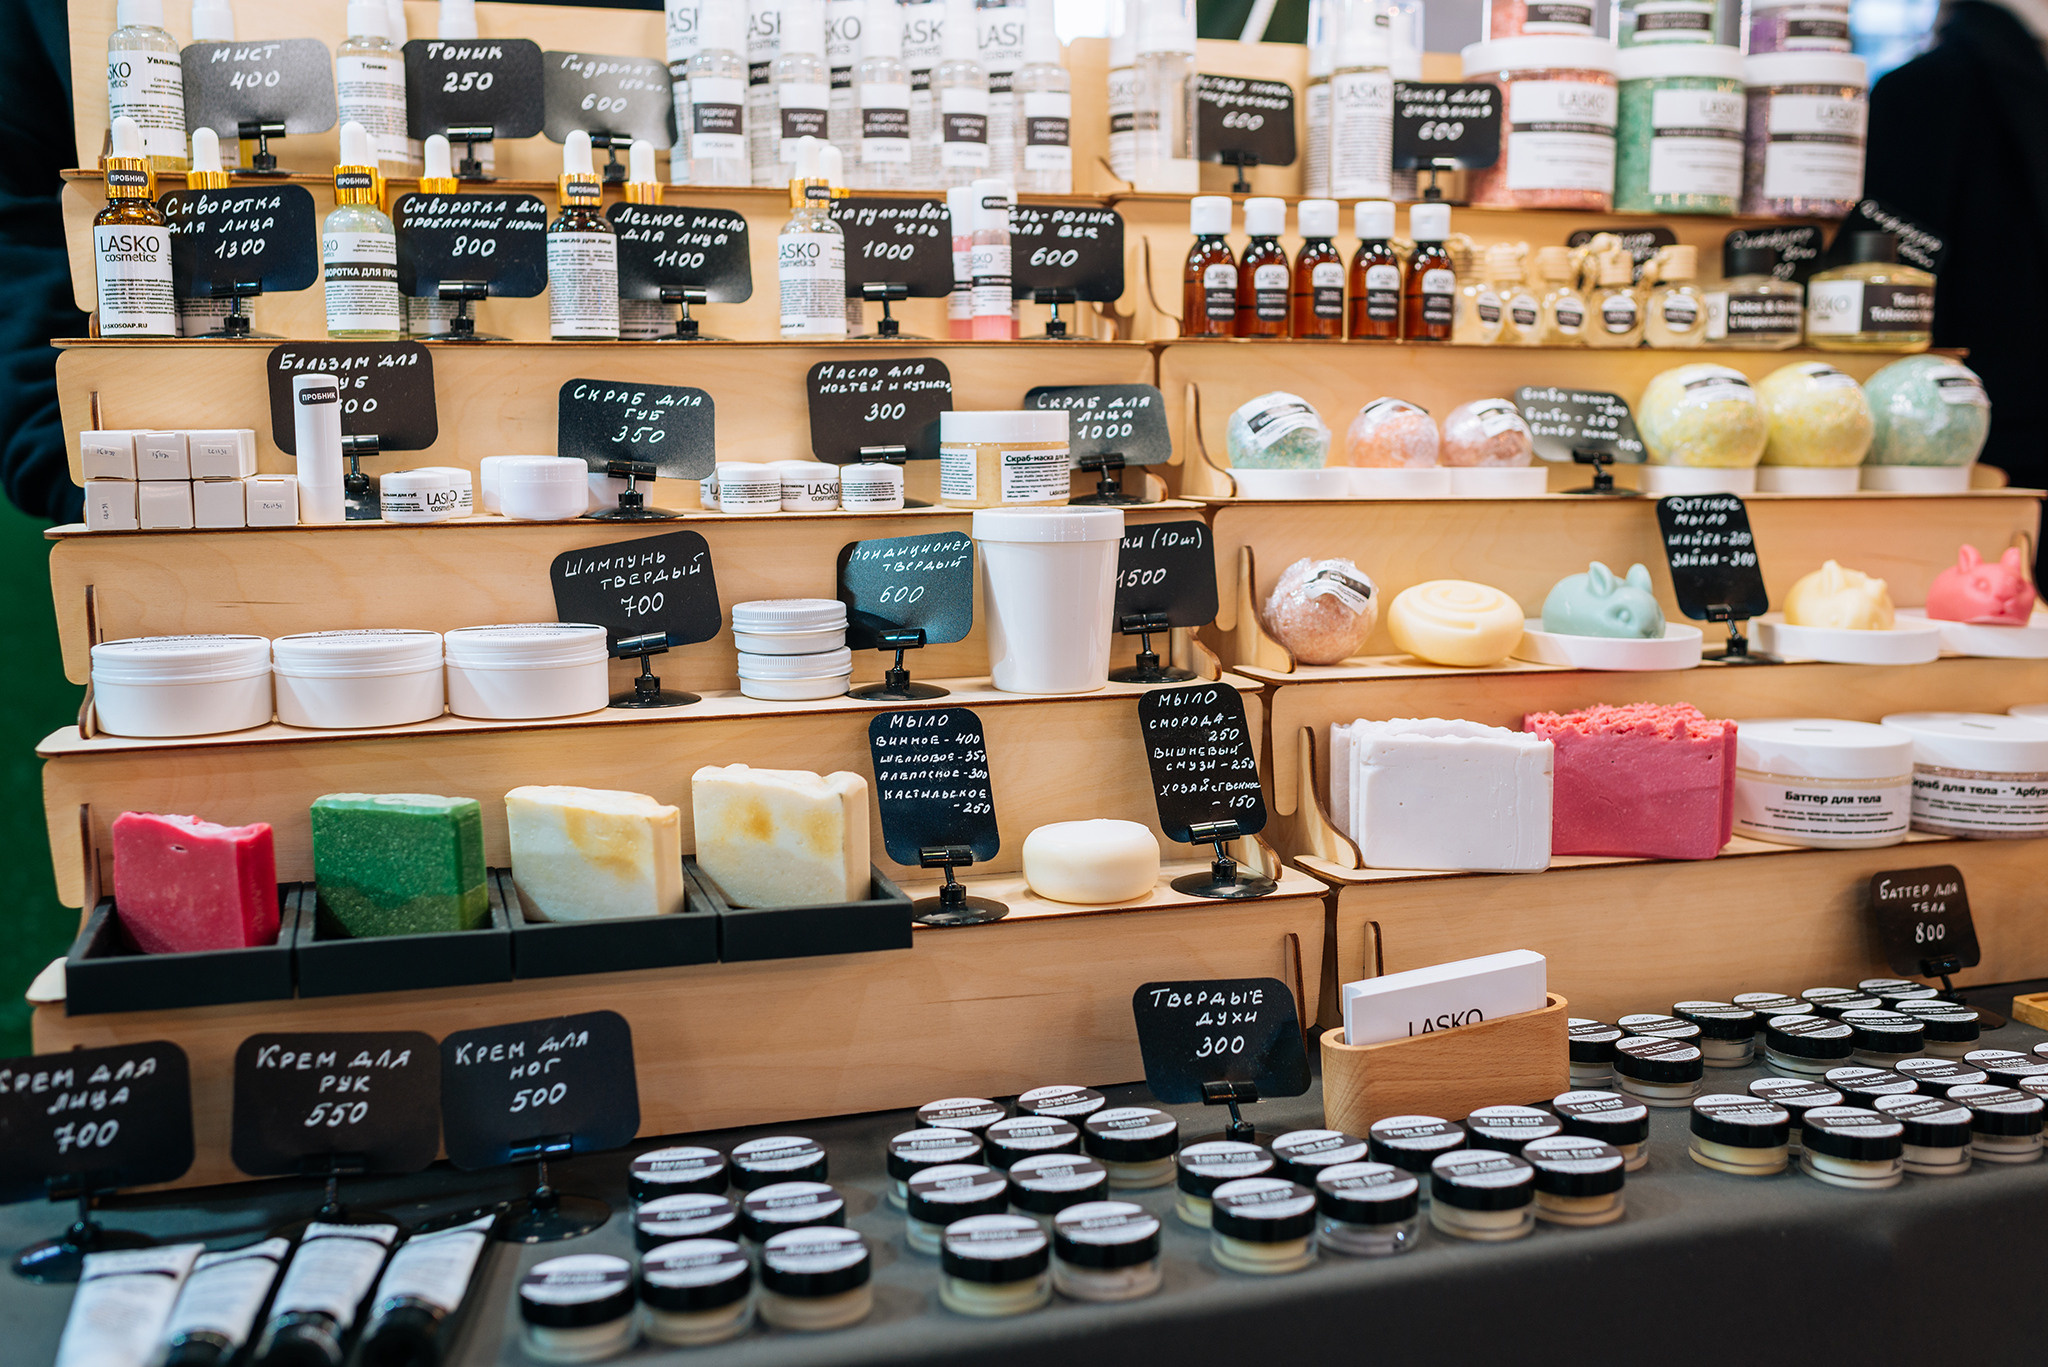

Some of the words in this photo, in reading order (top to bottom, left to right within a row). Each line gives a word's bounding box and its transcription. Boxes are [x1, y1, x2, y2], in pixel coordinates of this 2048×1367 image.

[230, 70, 280, 90] 400
[443, 72, 493, 93] 250
[581, 93, 627, 113] 600
[1222, 111, 1264, 131] 600
[1418, 121, 1464, 141] 600
[110, 174, 145, 183] ПРОБНИК
[337, 177, 370, 186] ПРОБНИК
[100, 235, 160, 253] LASKO
[215, 238, 266, 259] 1300
[452, 235, 497, 258] 800
[861, 241, 915, 262] 1000
[104, 252, 157, 263] cosmetics
[653, 250, 706, 269] 1100
[1030, 247, 1079, 267] 600
[302, 391, 336, 402] ПРОБНИК
[864, 402, 906, 422] 300
[611, 425, 666, 444] 350
[1077, 423, 1133, 440] 1000
[1115, 567, 1168, 589] 1500
[620, 592, 665, 617] 700
[879, 585, 925, 604] 600
[955, 733, 980, 744] 400
[1208, 728, 1239, 741] 250
[1785, 790, 1828, 804] Баттер
[1831, 793, 1854, 804] для
[1858, 793, 1882, 803] тела
[1942, 783, 1966, 793] для
[1969, 785, 1998, 795] тела
[1915, 922, 1946, 943] 800
[1196, 1035, 1245, 1059] 300
[509, 1082, 568, 1113] 500
[304, 1101, 369, 1128] 550
[53, 1119, 120, 1154] 700
